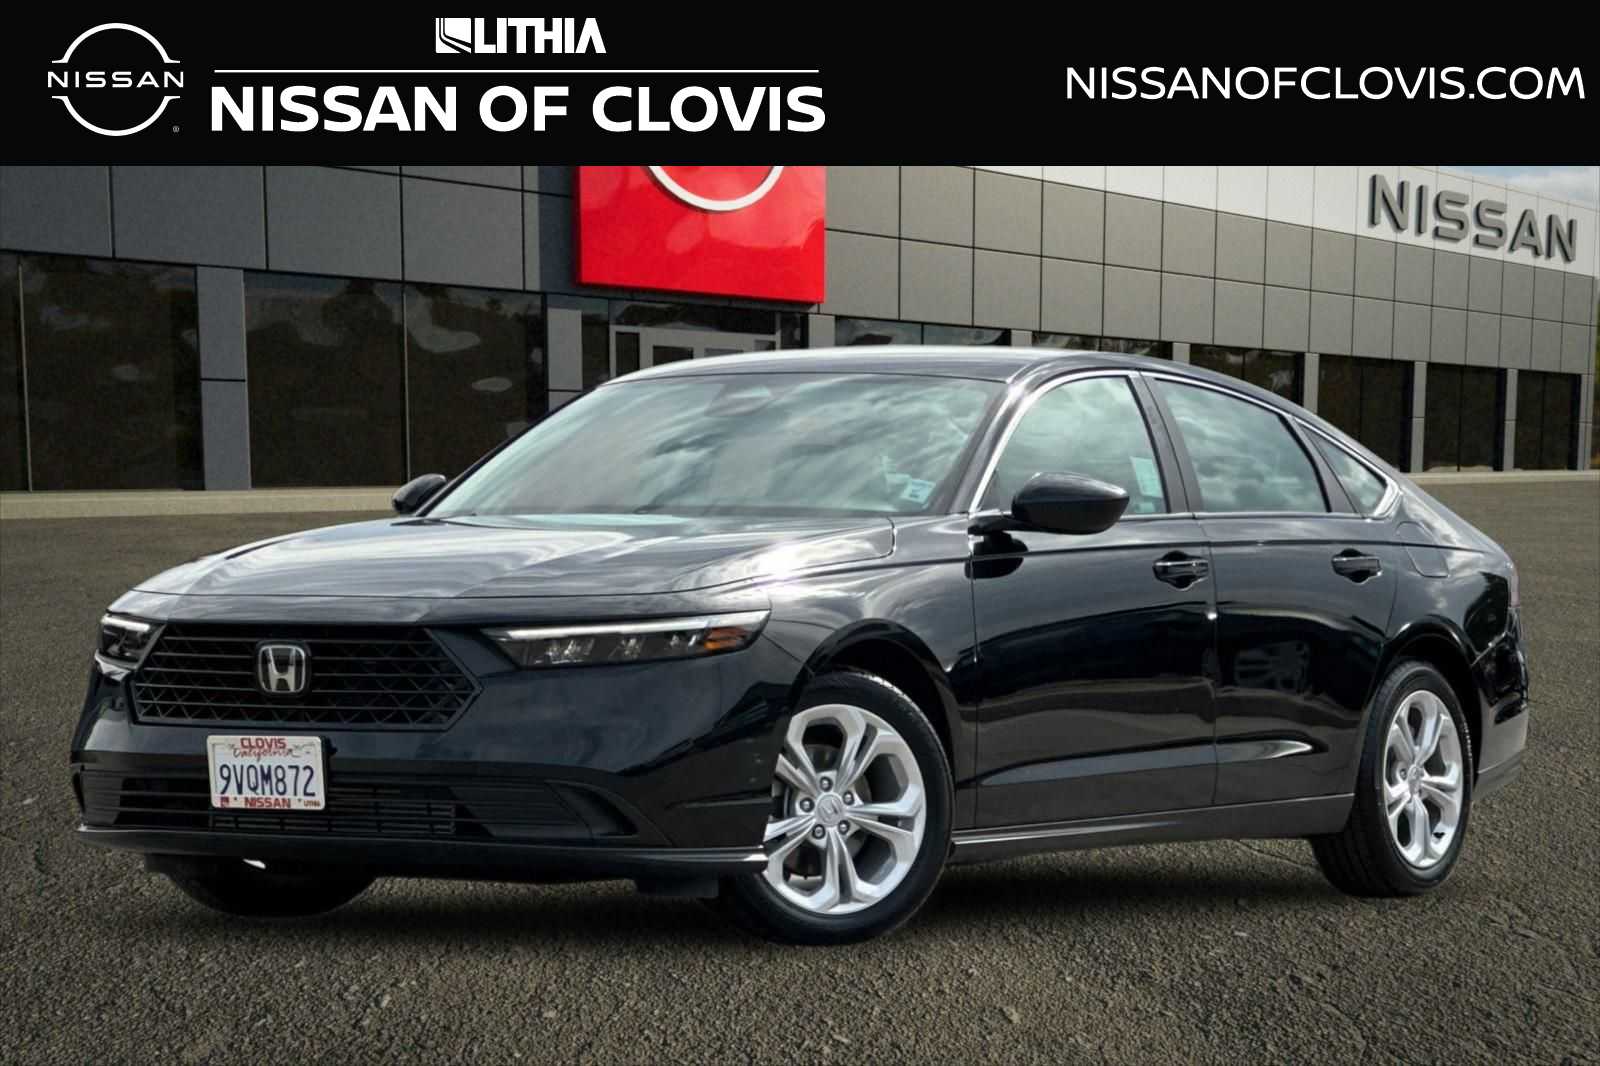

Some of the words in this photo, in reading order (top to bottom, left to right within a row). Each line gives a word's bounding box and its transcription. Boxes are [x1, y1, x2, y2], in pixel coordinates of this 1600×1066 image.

[1368, 174, 1577, 263] NISSAN
[240, 738, 287, 749] CLOVIS
[219, 764, 316, 797] 9VQM872
[244, 797, 291, 809] NISSAN
